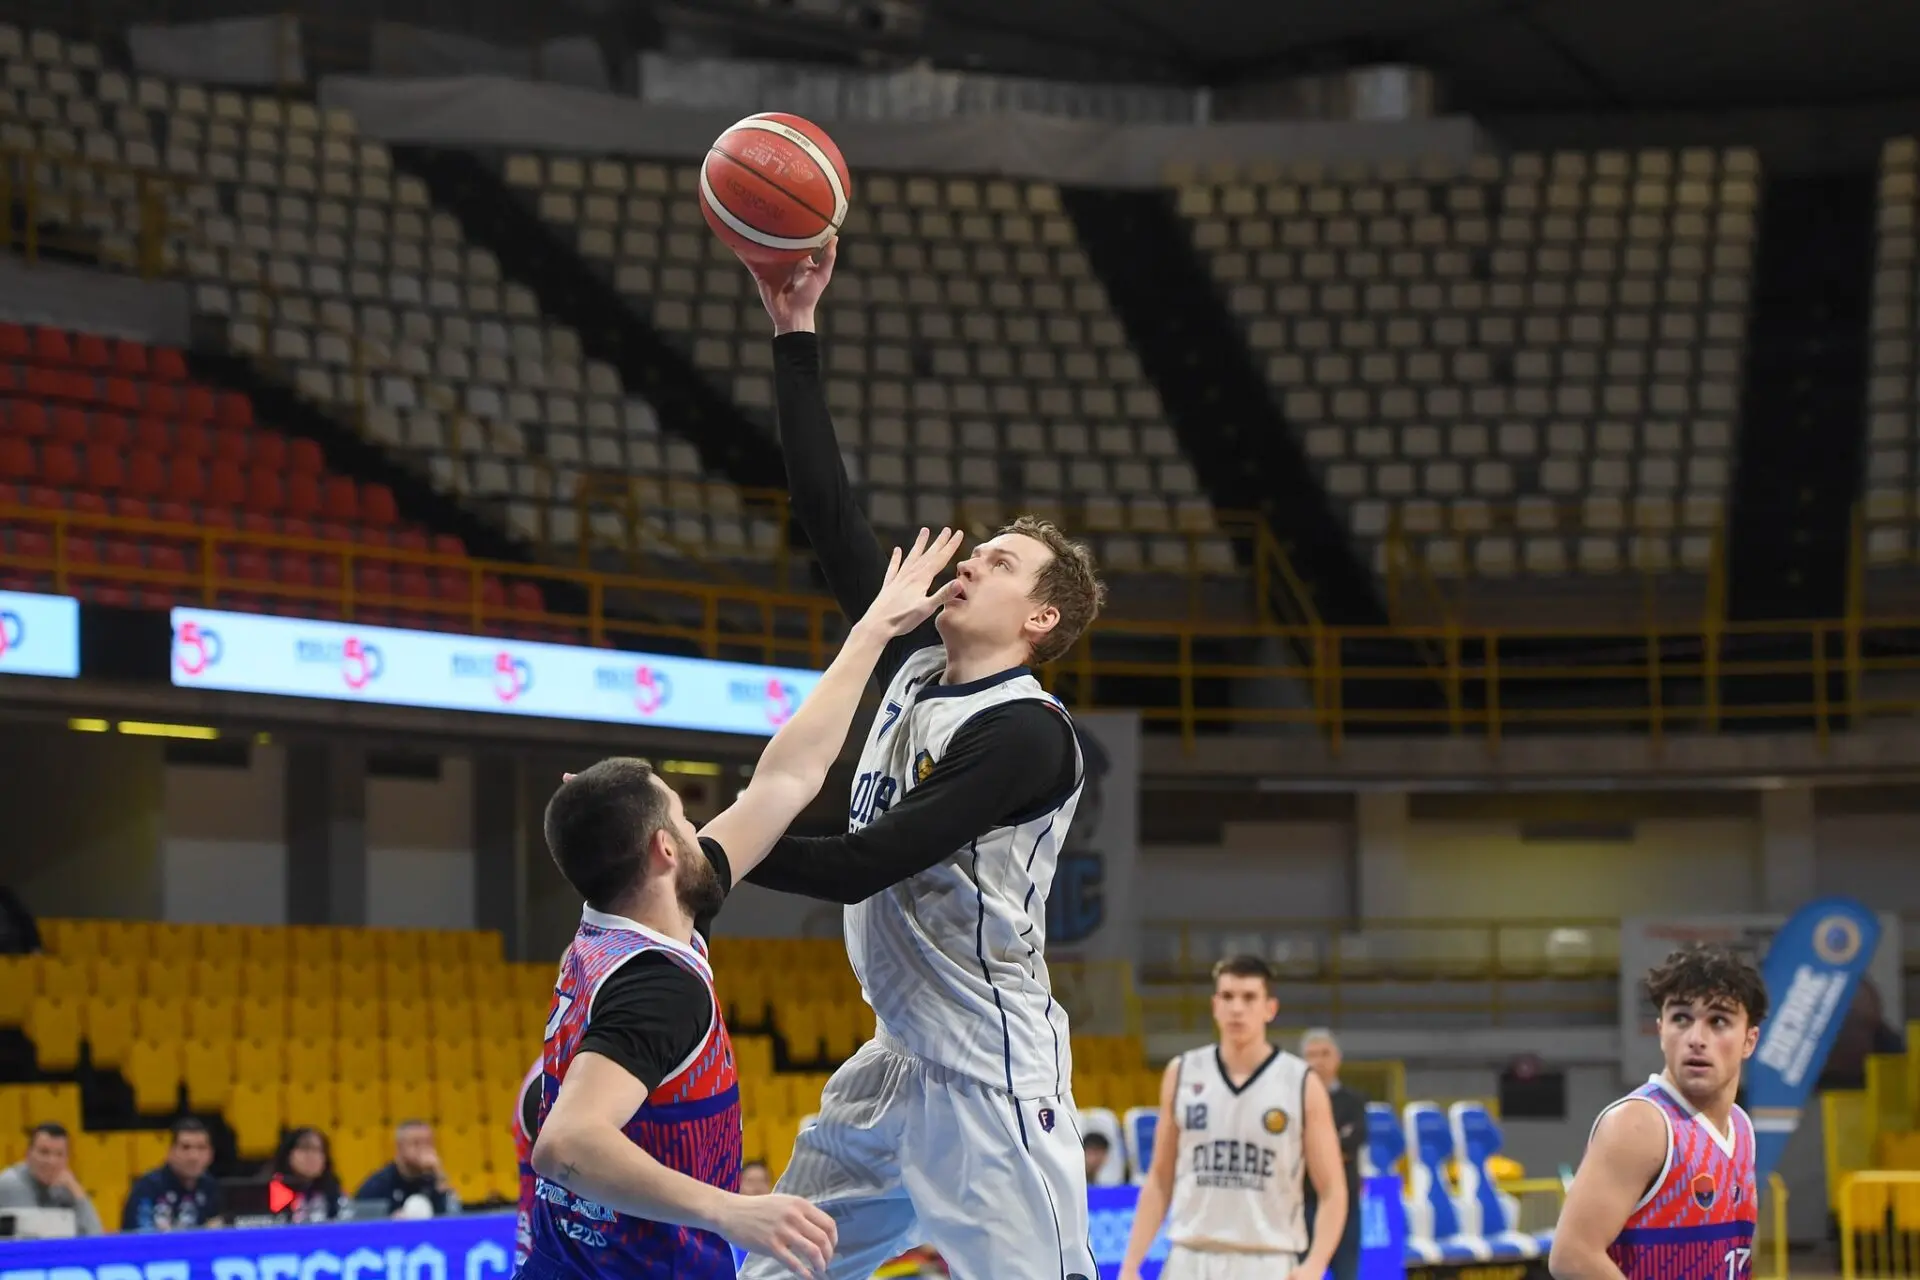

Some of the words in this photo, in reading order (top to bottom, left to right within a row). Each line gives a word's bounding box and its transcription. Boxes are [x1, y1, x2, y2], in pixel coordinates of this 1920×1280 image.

[877, 700, 903, 742] 7
[1186, 1103, 1207, 1130] 12
[1724, 1247, 1751, 1280] 17
